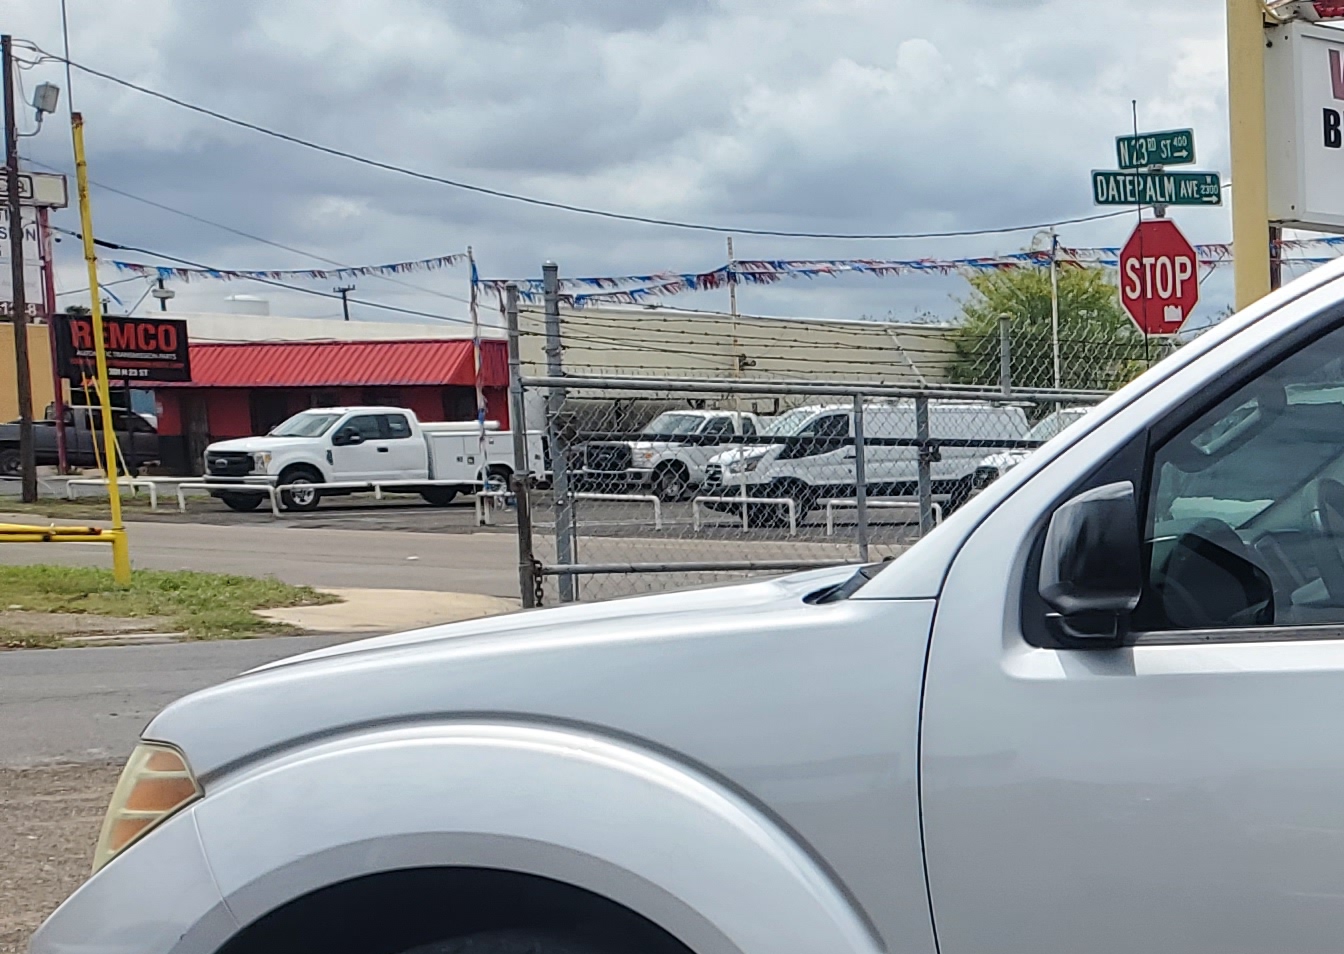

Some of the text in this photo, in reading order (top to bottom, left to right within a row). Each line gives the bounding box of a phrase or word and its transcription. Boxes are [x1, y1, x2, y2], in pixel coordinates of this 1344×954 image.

[1119, 141, 1129, 167] N
[1160, 140, 1172, 159] ST
[1180, 180, 1200, 198] AVE
[1200, 185, 1219, 195] 2300
[1125, 255, 1193, 300] STOP
